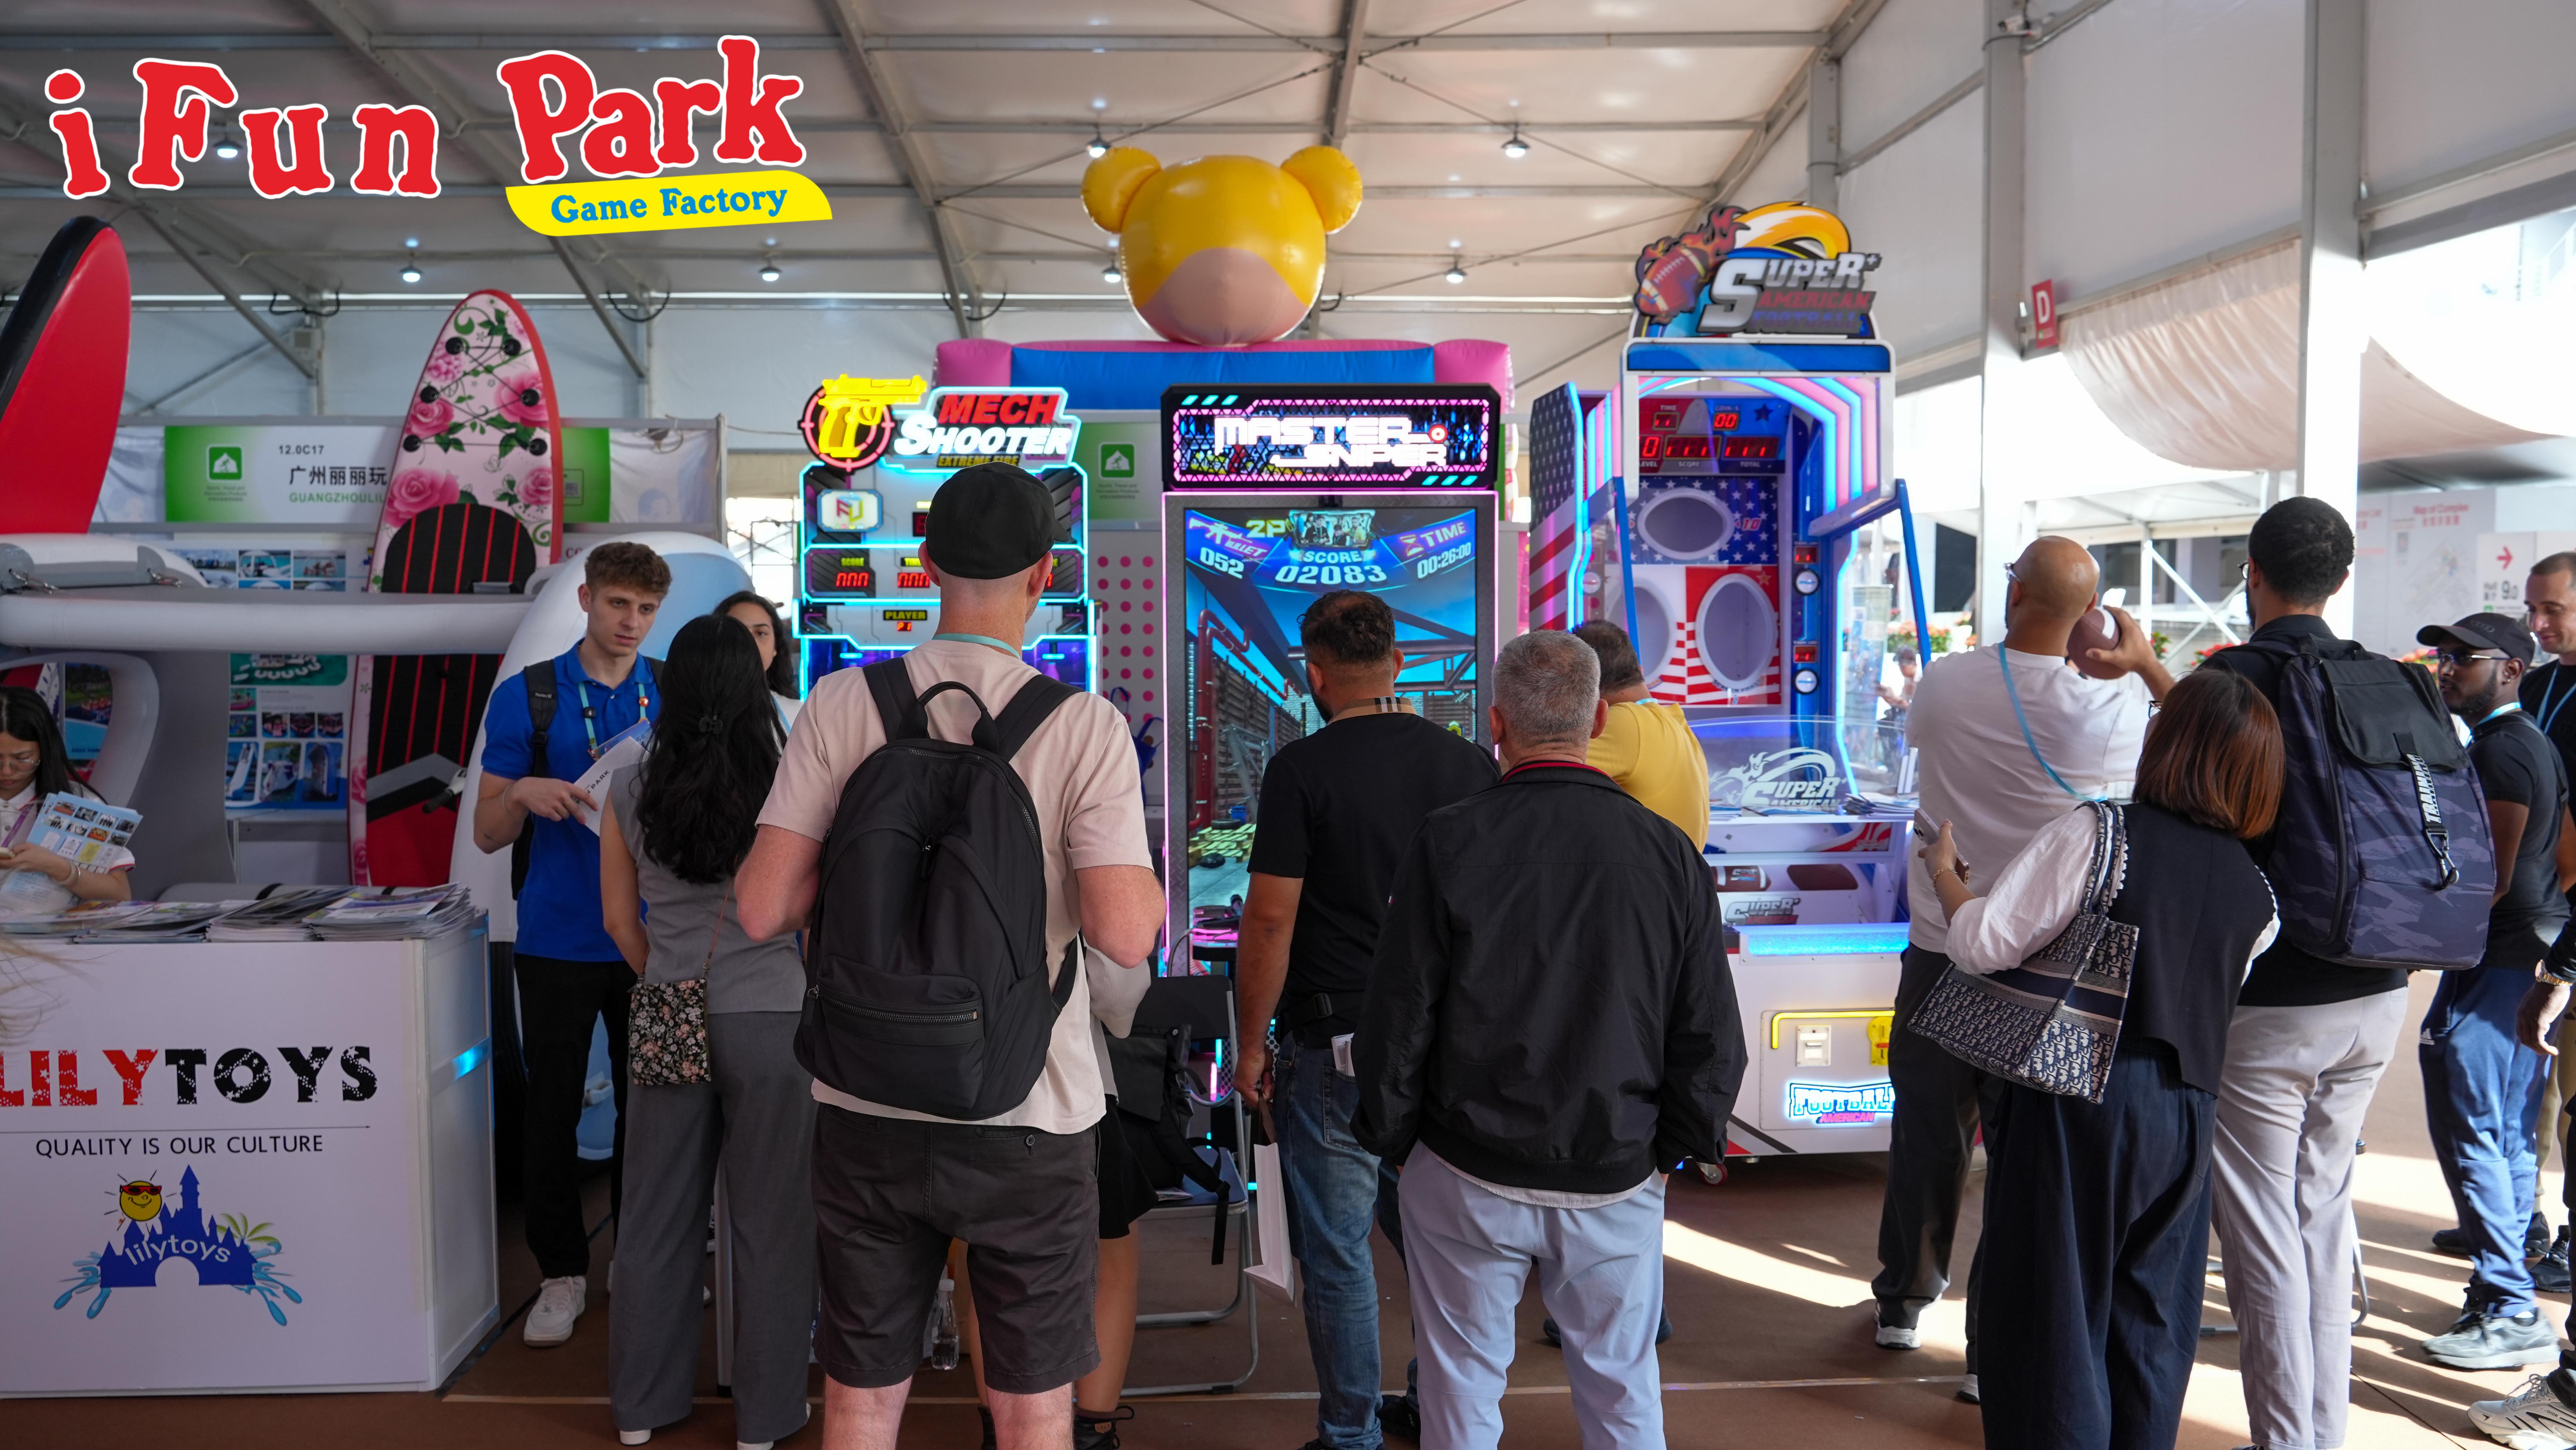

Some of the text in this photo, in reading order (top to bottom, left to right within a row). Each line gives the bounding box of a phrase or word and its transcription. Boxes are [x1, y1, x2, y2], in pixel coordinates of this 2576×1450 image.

[1700, 253, 1866, 328] SUPER
[1757, 292, 1872, 308] AMERICAN
[2036, 290, 2051, 324] D
[938, 394, 1060, 424] MECH
[894, 414, 1072, 455] SHOOTER
[1214, 417, 1431, 456] MASTER
[279, 444, 325, 455] 12.0C17
[938, 455, 992, 467] EXTREME
[1270, 444, 1447, 467] SNIPER
[289, 465, 387, 485] 广州丽丽玩
[1245, 519, 1286, 538] 2P
[1420, 521, 1466, 547] TIME
[1742, 518, 1762, 531] 10
[1224, 538, 1268, 557] BULLET
[1303, 550, 1363, 564] SCORE
[1200, 547, 1244, 579] 052
[1417, 542, 1471, 579] 00:26:00
[1275, 565, 1387, 585] 02083
[885, 611, 926, 620] PLAYER
[591, 770, 610, 789] PARK
[1741, 777, 1841, 805] SUPER
[2406, 754, 2442, 824] TRAINING
[1819, 1112, 1875, 1123] AMERICAN
[36, 1135, 323, 1158] QUALITY IS OUR CULTURE
[124, 1234, 230, 1265] lilytoys
